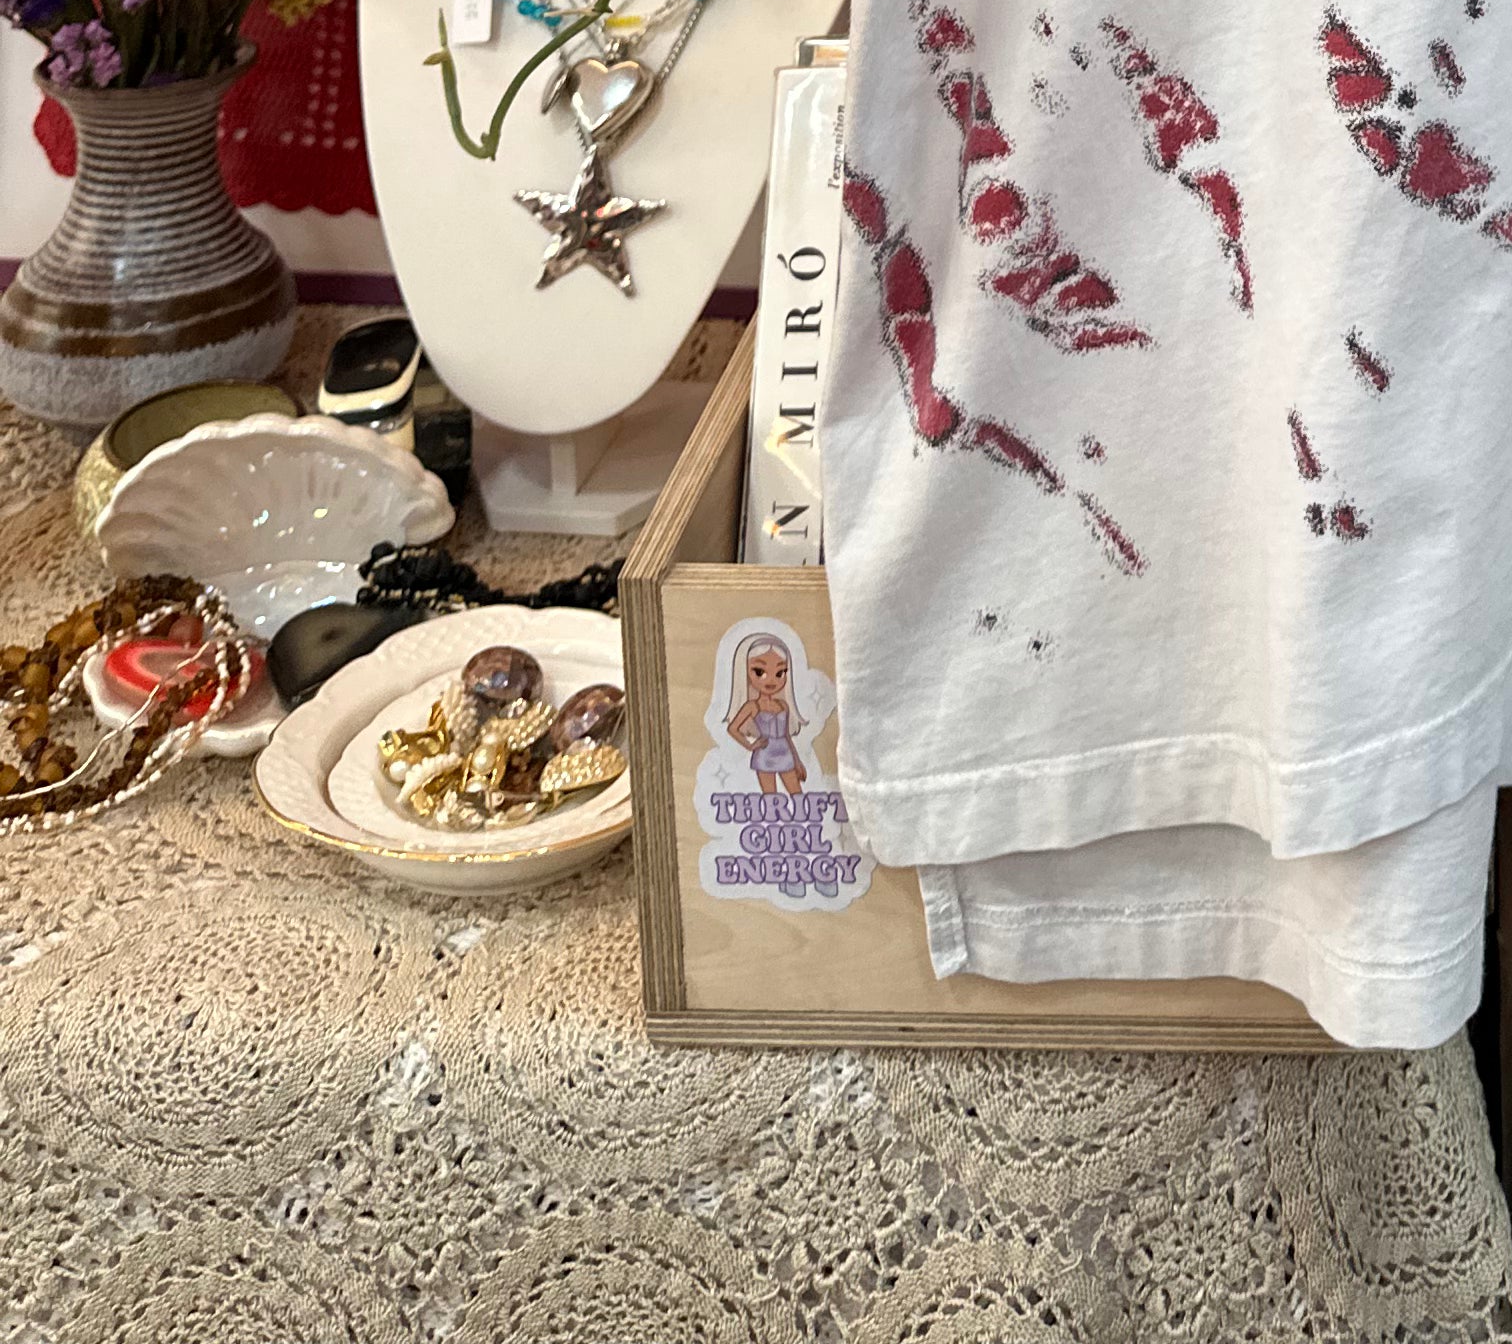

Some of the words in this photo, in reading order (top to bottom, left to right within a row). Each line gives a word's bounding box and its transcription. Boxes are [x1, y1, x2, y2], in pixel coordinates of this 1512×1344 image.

[827, 104, 845, 190] l'exposition
[776, 246, 826, 448] MIRÓ
[711, 792, 848, 823] THRIFT
[739, 824, 833, 855] GIRL
[715, 855, 863, 884] ENERGY
